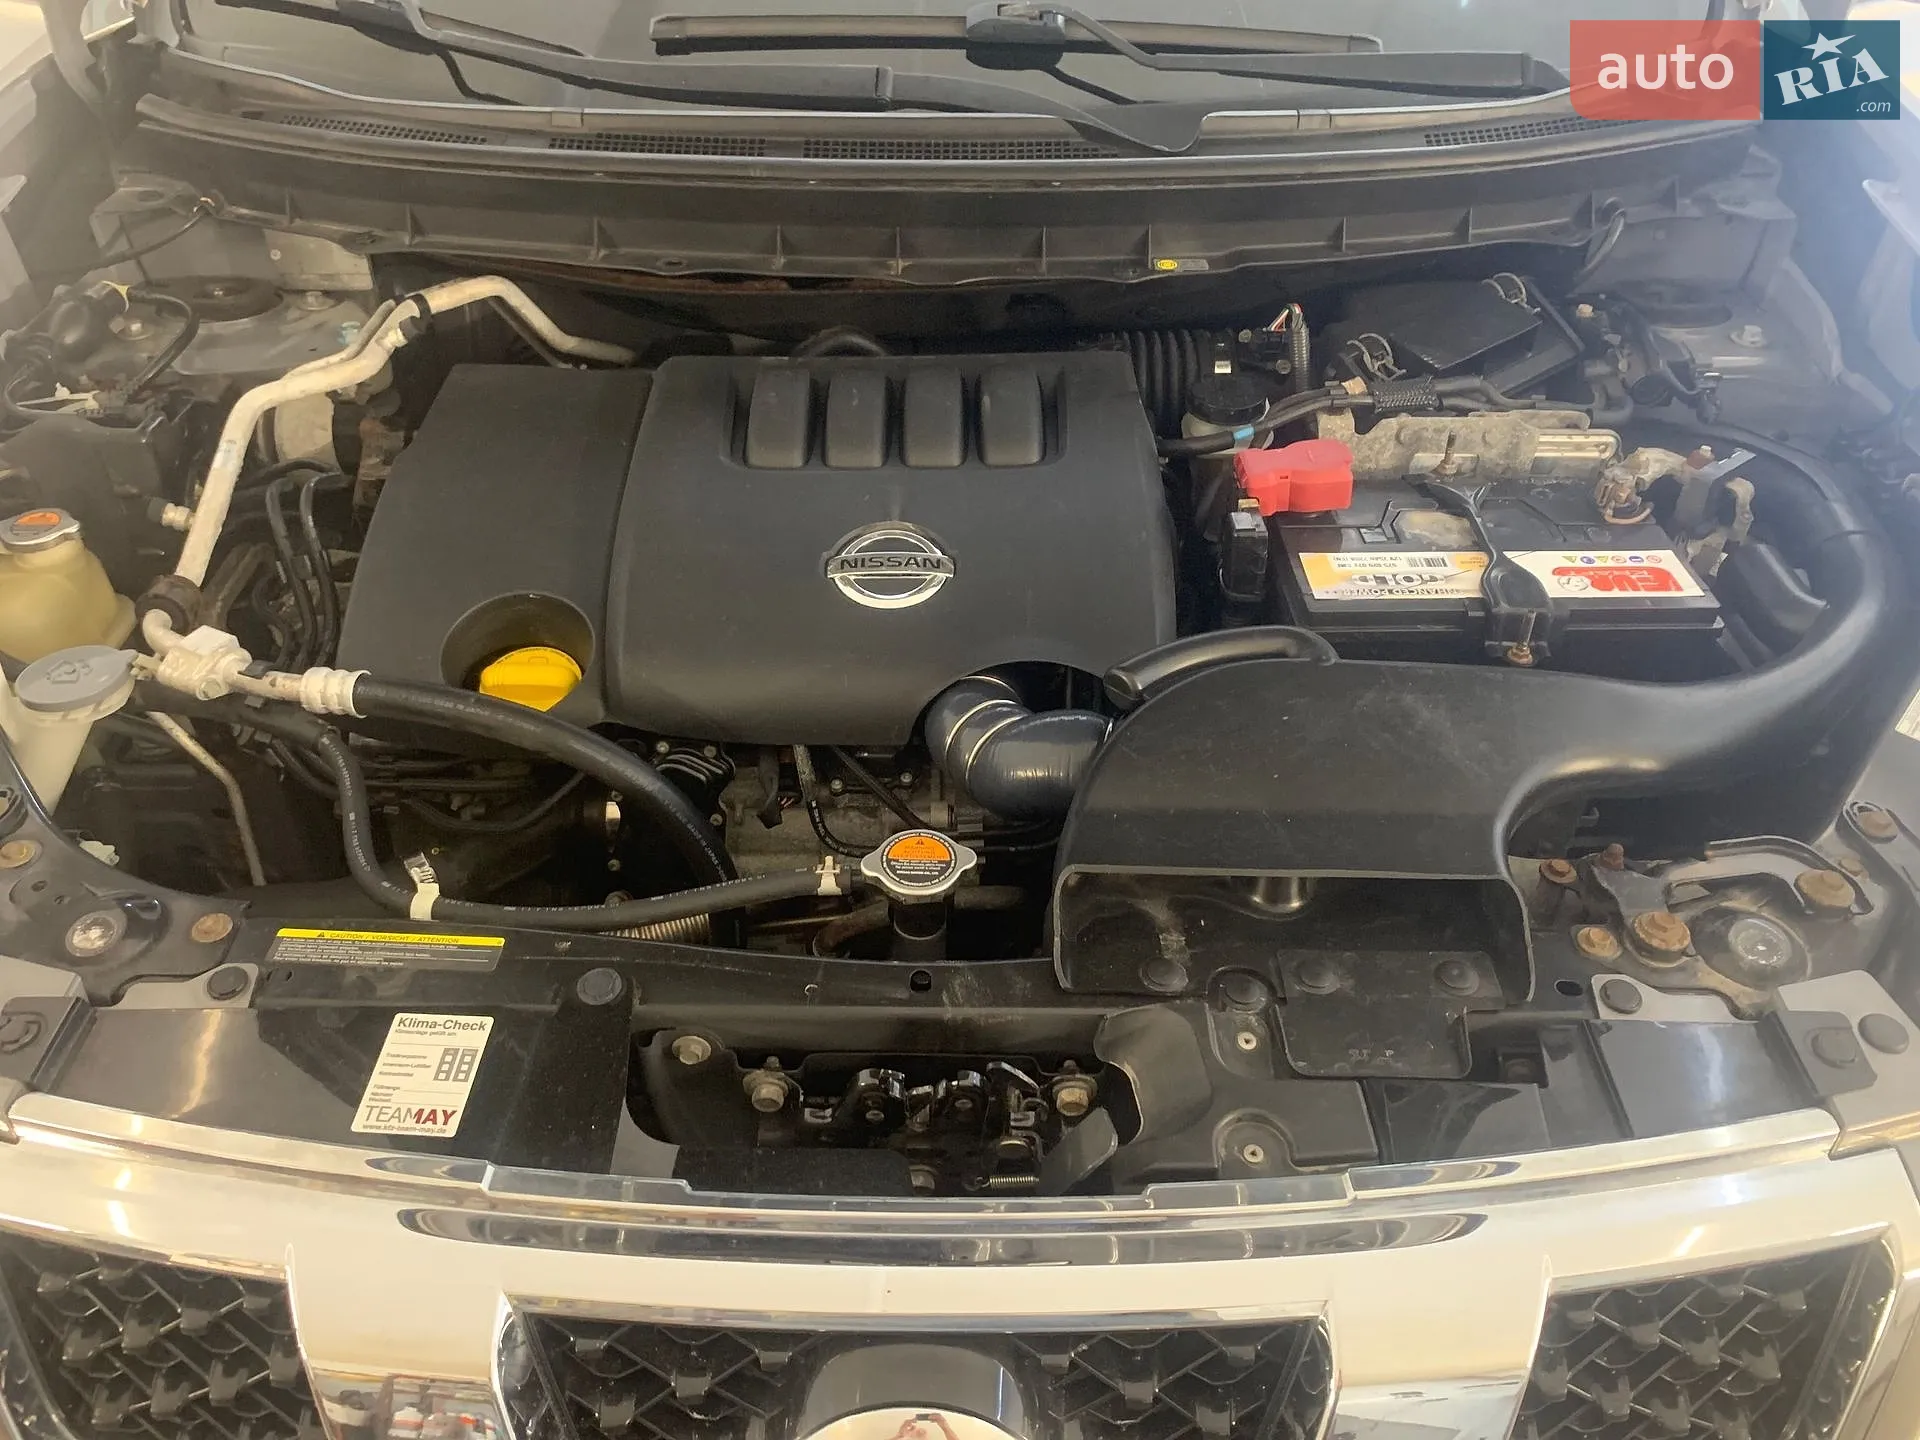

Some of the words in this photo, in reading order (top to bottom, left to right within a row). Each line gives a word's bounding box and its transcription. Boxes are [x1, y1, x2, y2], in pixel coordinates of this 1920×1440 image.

[840, 556, 942, 570] NISSAN
[1351, 573, 1446, 587] GOLD
[329, 932, 365, 940] CAUTION
[371, 934, 410, 942] VORSICHT
[417, 936, 460, 944] ATTENTION
[397, 1016, 488, 1031] Klima-Check
